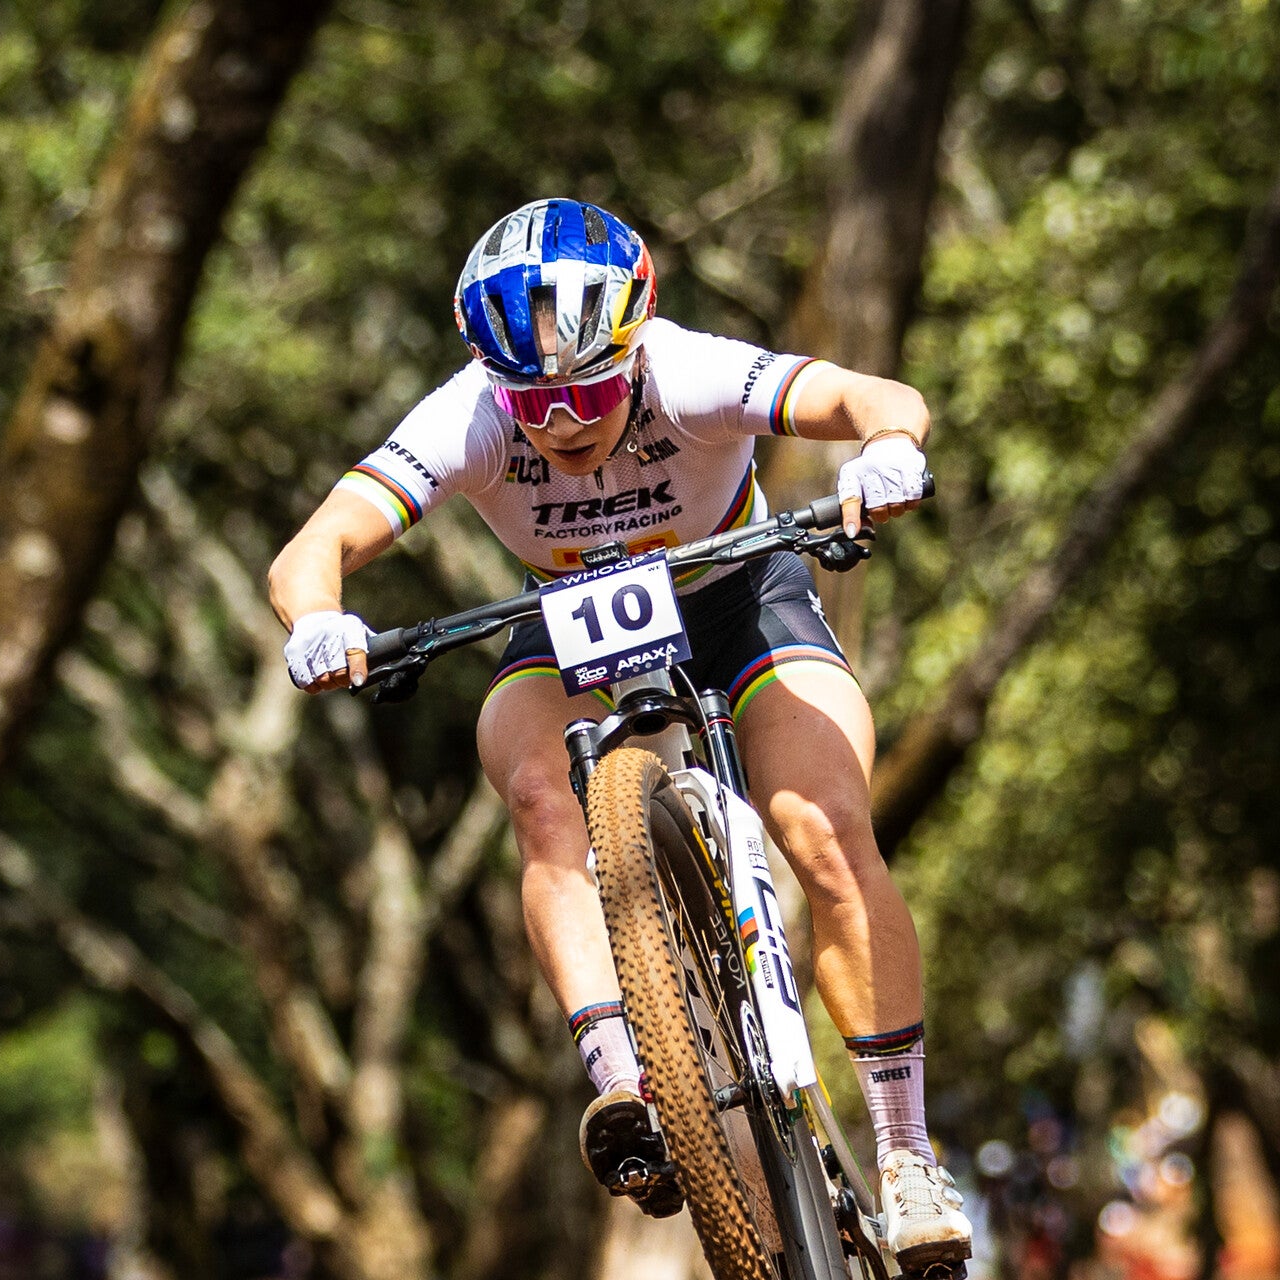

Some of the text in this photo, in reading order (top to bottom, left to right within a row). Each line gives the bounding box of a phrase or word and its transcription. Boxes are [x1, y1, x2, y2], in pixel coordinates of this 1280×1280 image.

[381, 439, 439, 489] RAM
[532, 479, 677, 525] TREK
[534, 505, 683, 539] FACTORY RACING
[562, 556, 645, 586] WHOOP
[571, 584, 653, 644] 10
[577, 666, 608, 683] XCO
[709, 913, 747, 990] KOVEE
[871, 1066, 911, 1083] DEFEET
